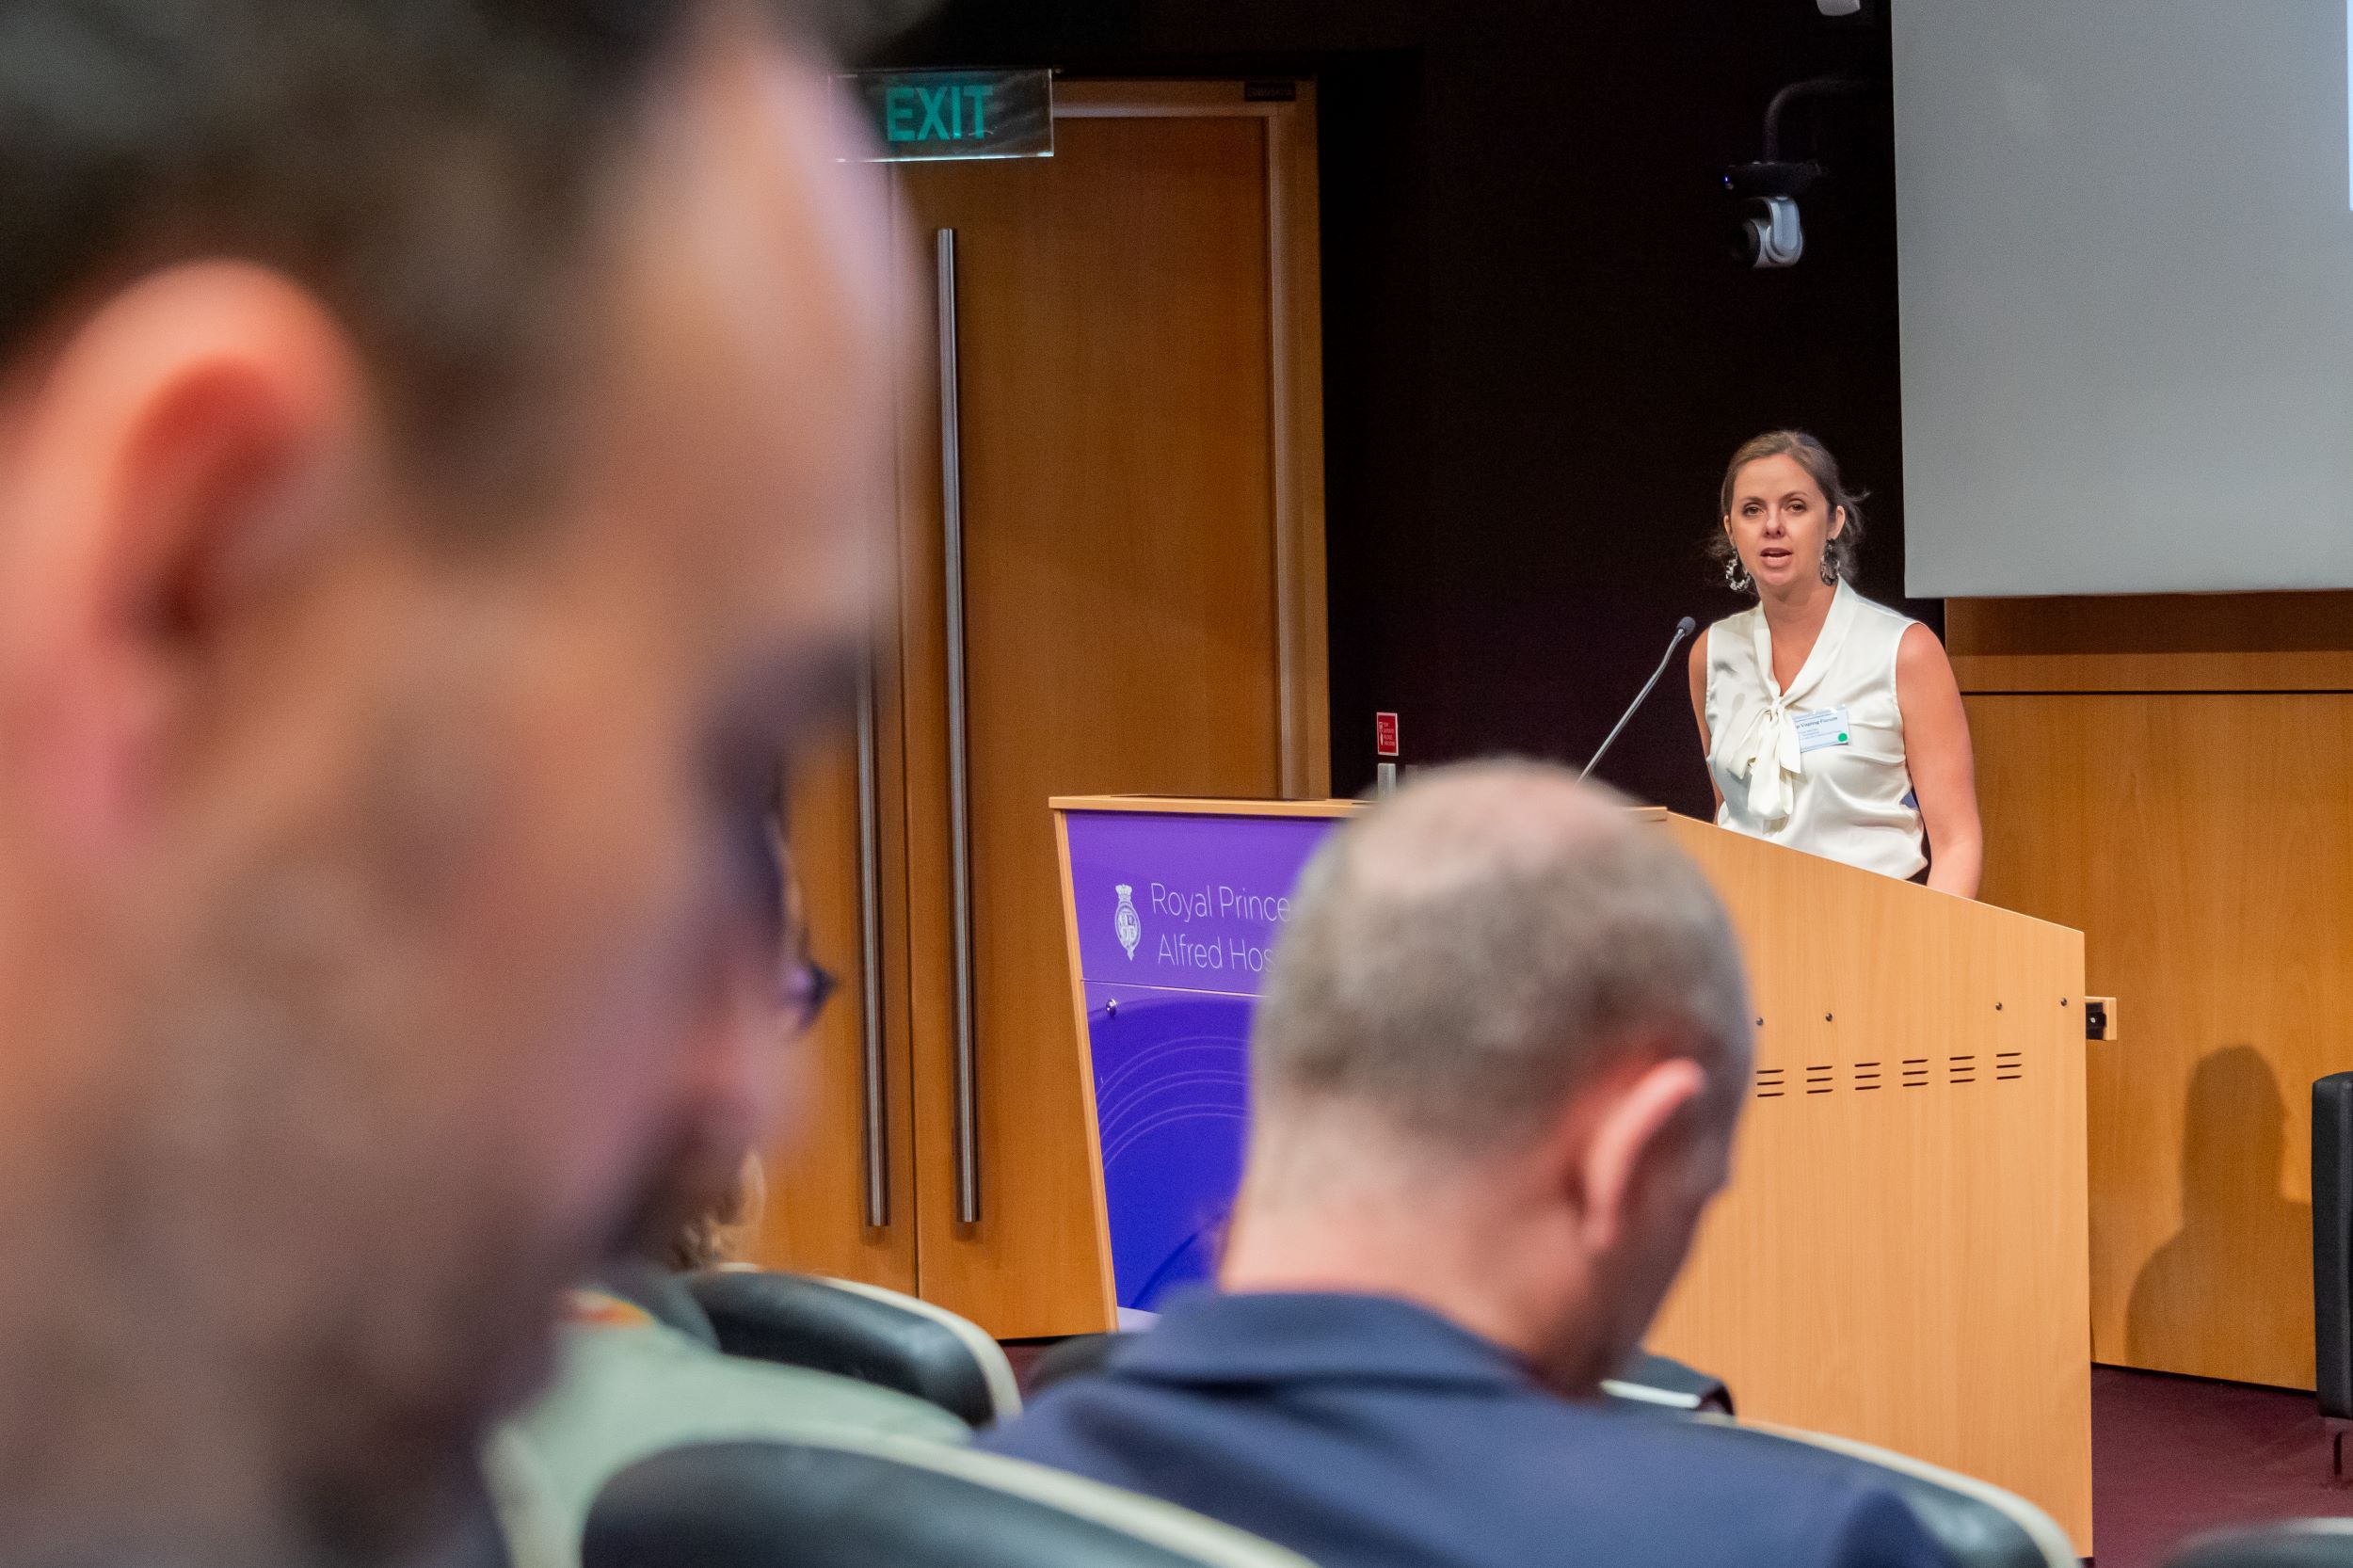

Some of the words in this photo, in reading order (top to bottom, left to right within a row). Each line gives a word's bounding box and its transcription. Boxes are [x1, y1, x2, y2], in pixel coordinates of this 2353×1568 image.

[887, 86, 993, 141] EXIT
[1151, 883, 1212, 922] Royal
[1219, 886, 1291, 922] Prince
[1158, 933, 1223, 968] Alfred
[1229, 938, 1275, 972] Hos
